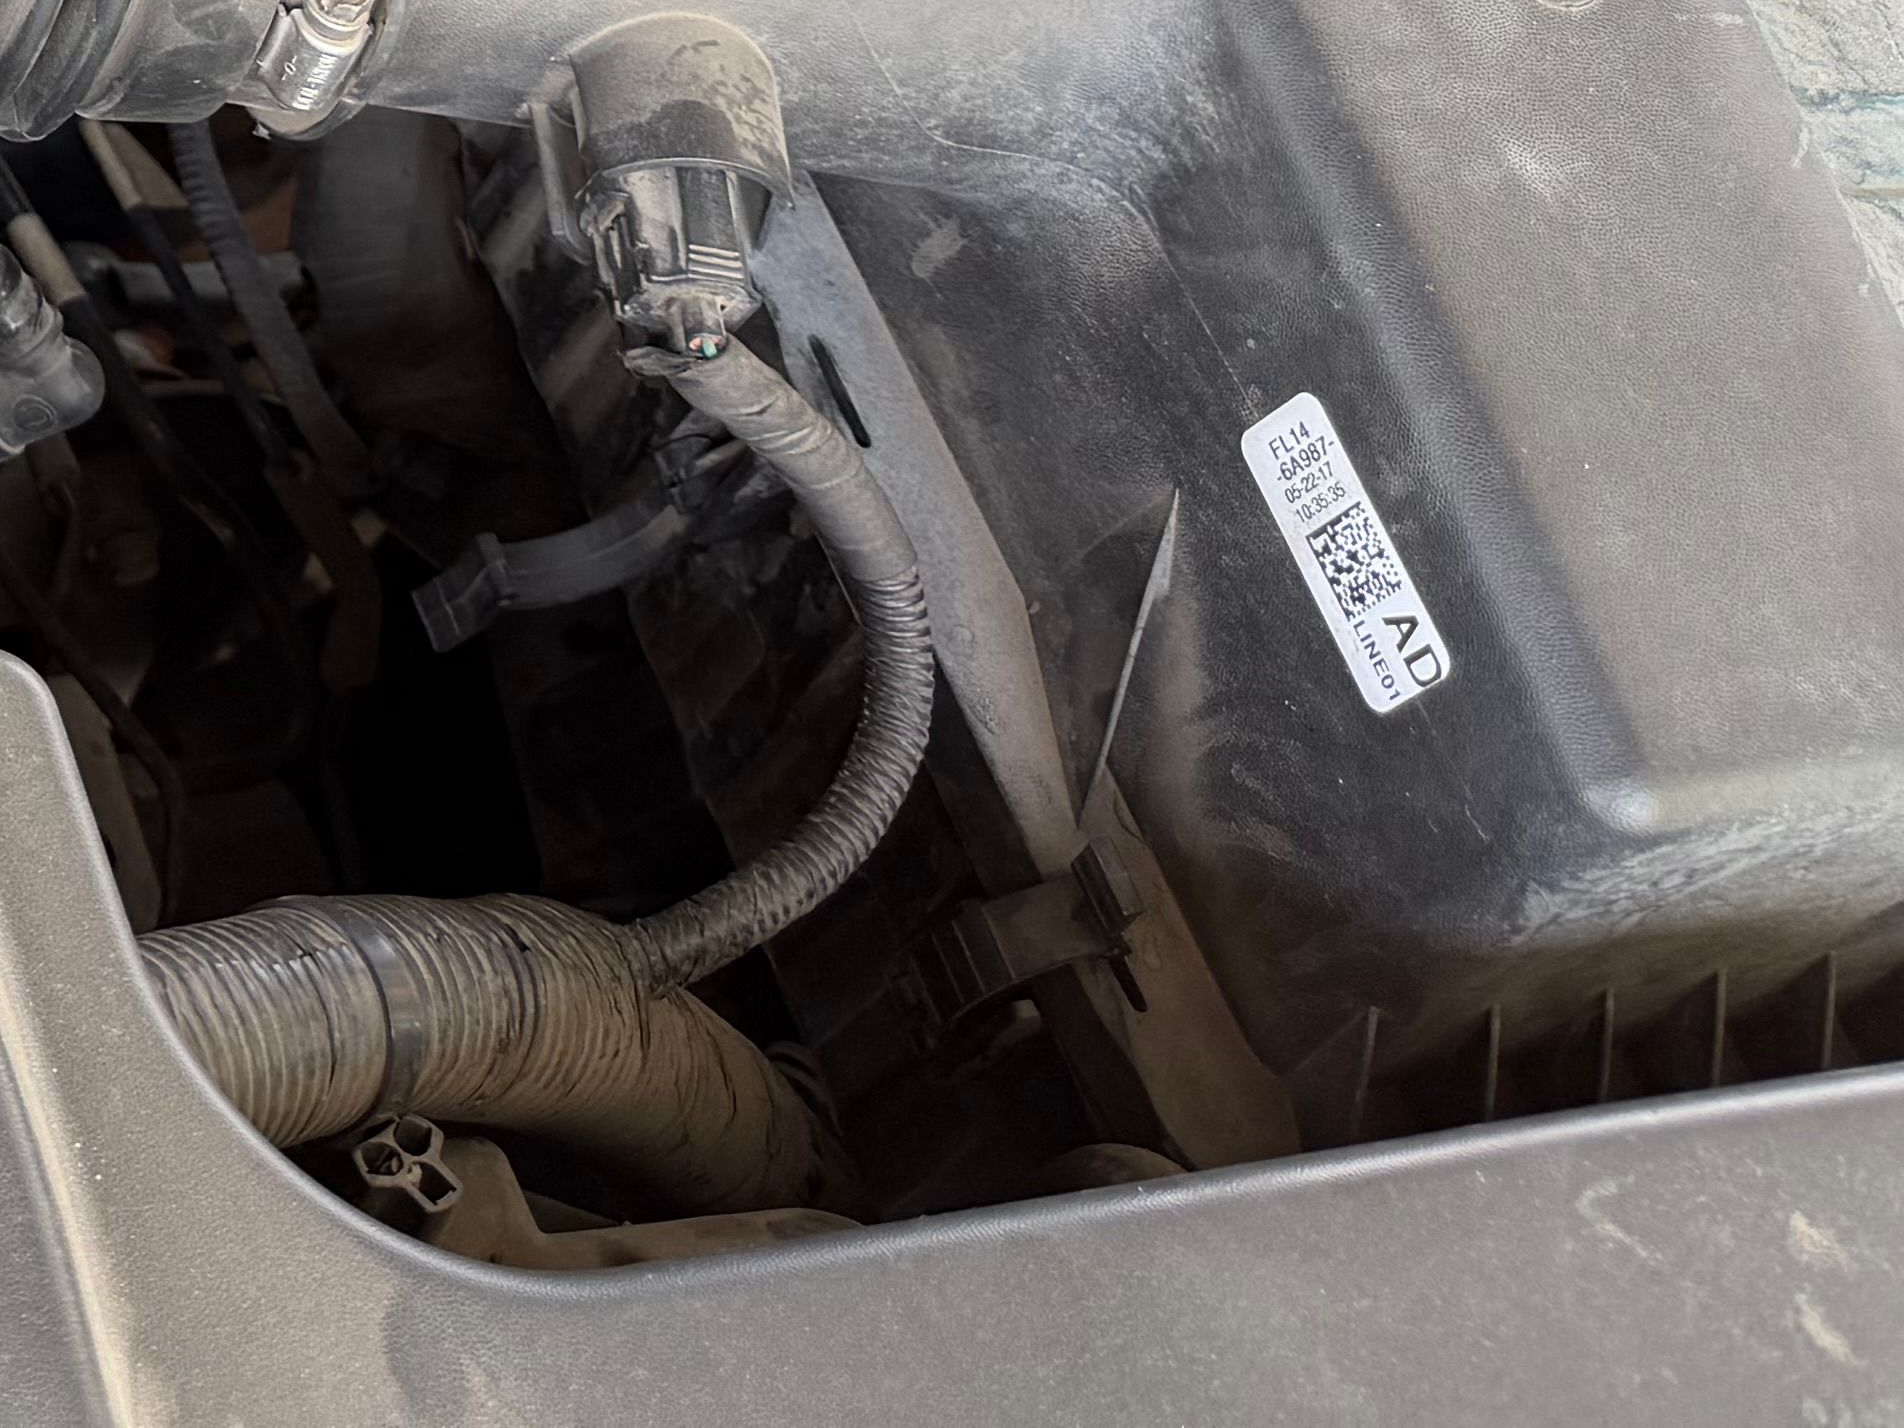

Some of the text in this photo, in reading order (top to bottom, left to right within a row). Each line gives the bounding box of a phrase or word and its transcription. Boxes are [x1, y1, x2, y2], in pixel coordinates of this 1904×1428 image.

[1268, 421, 1310, 460] FL14
[1277, 438, 1336, 482] -6A987-
[1285, 463, 1335, 504] 05-22-17
[1295, 482, 1346, 523] 10:35:35
[1353, 620, 1401, 701] LINE01
[1382, 614, 1443, 688] AD
